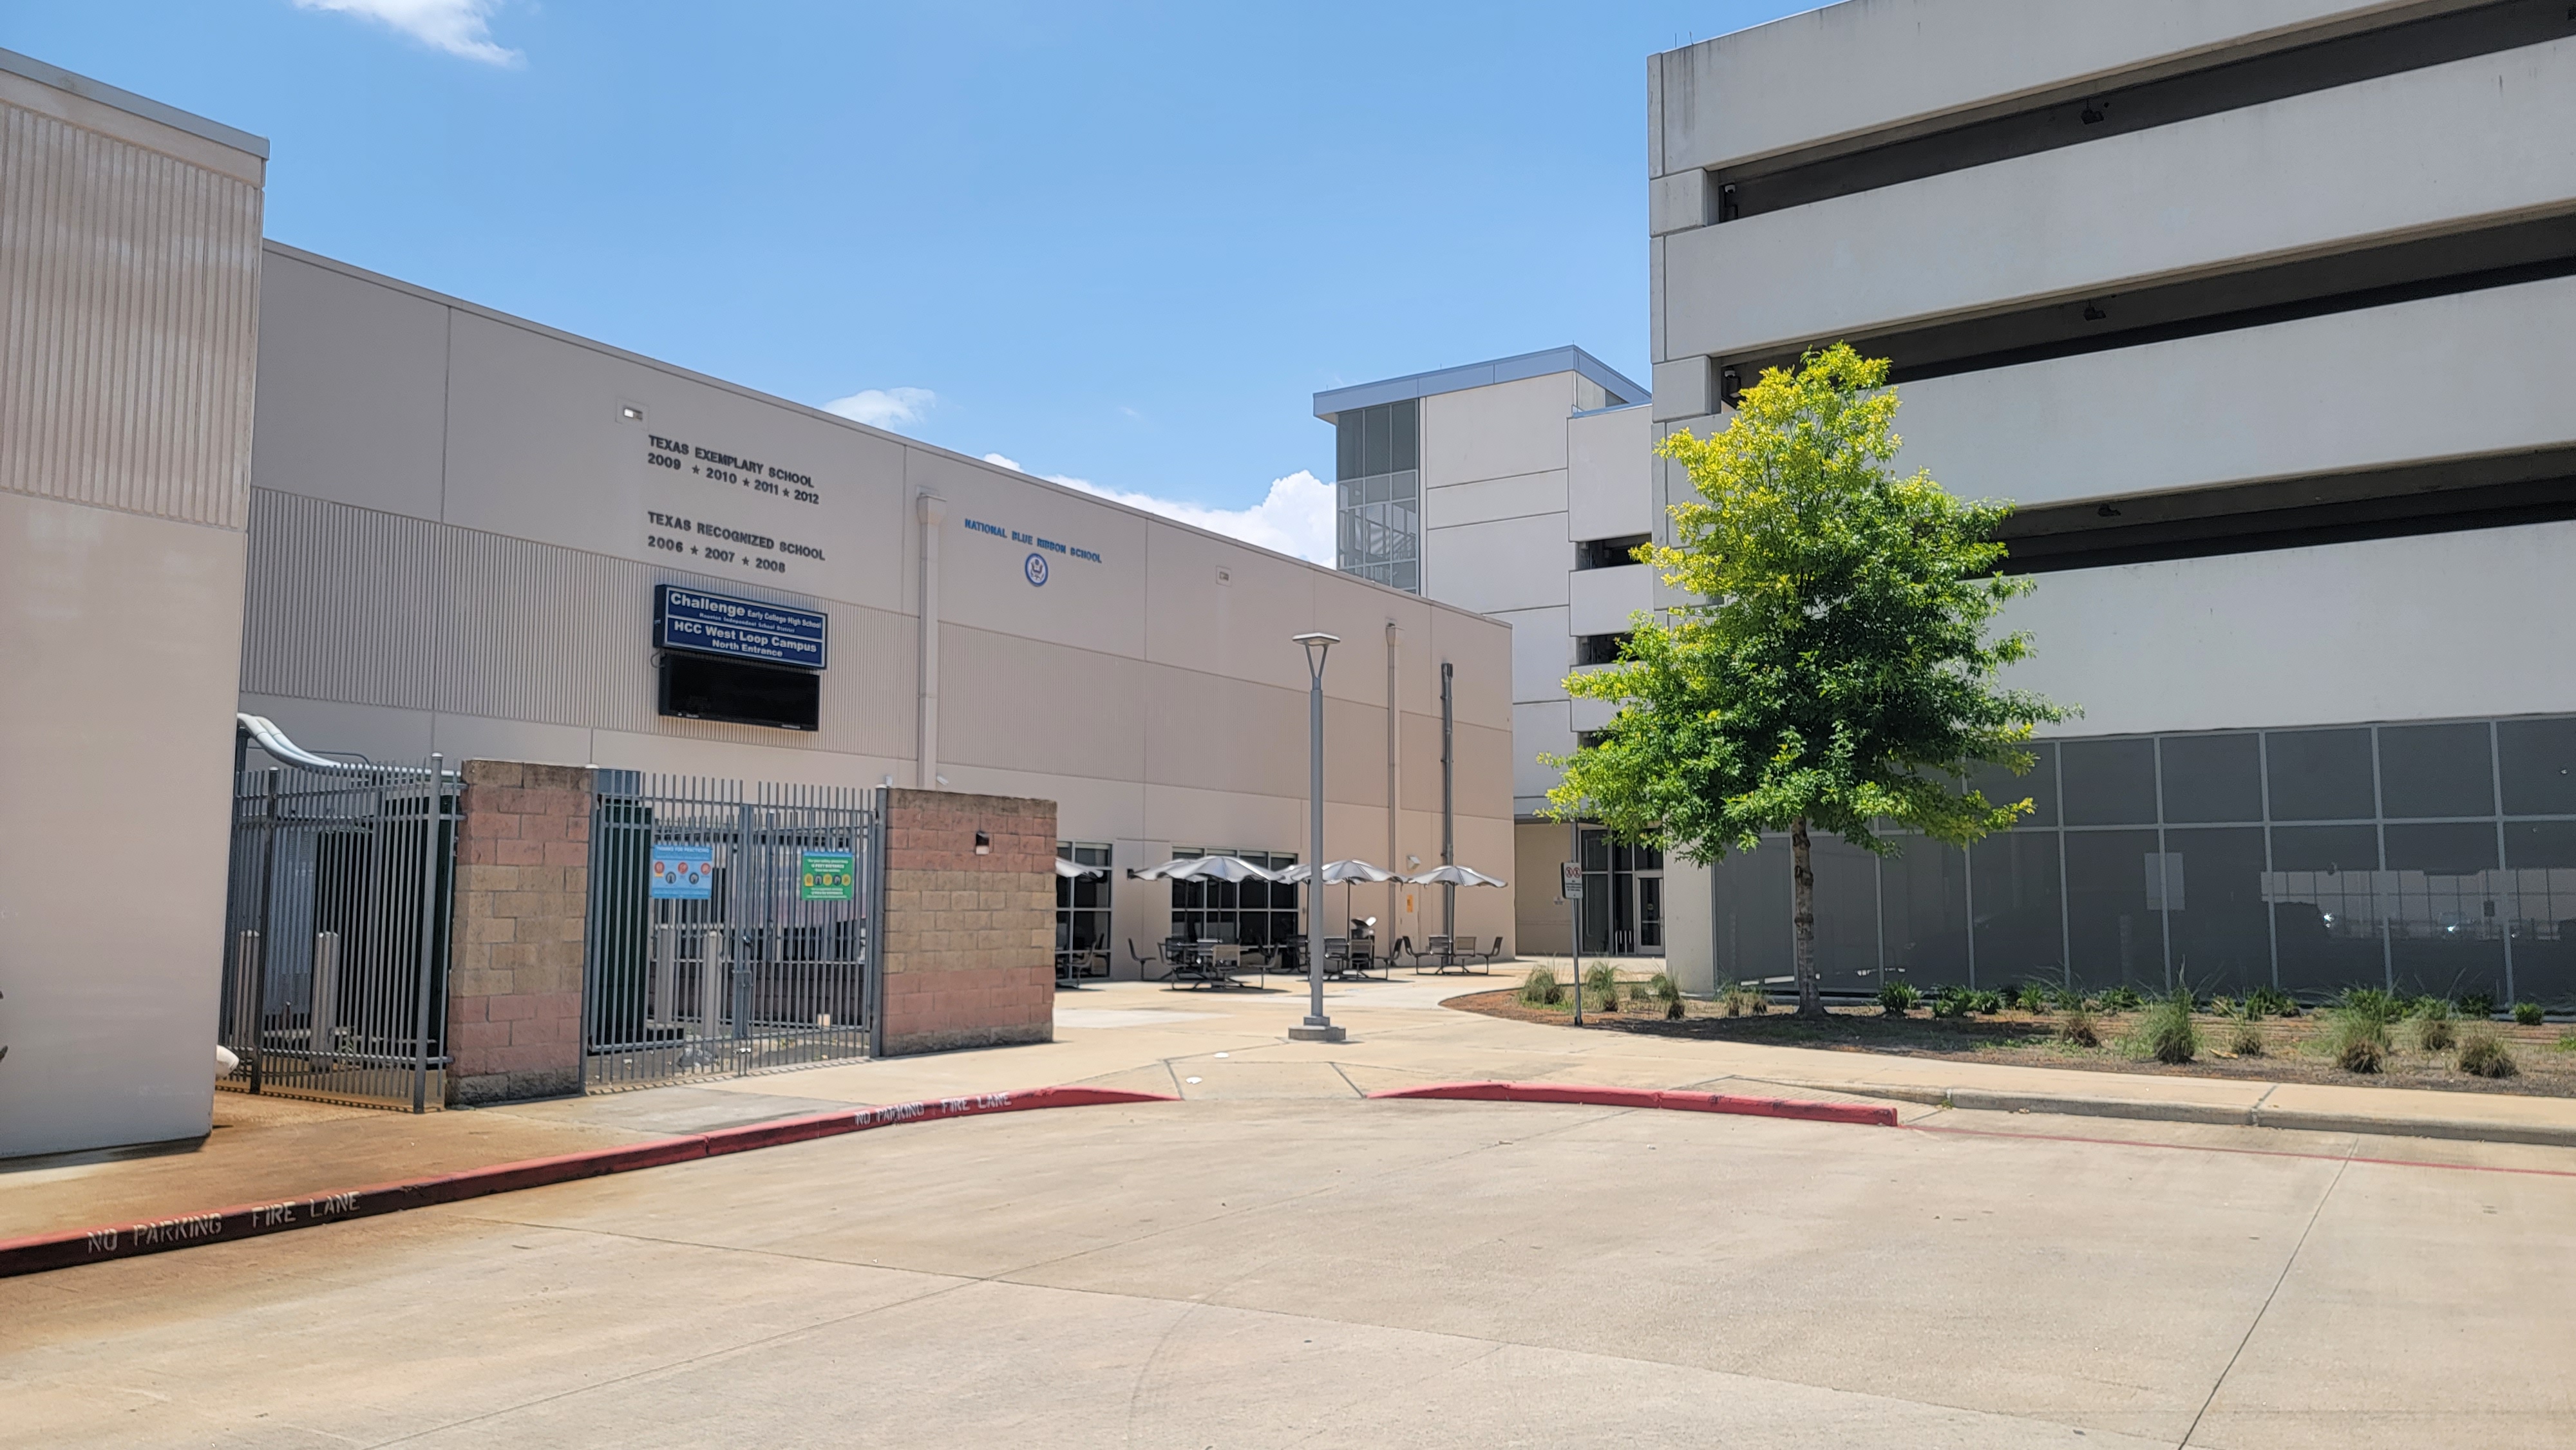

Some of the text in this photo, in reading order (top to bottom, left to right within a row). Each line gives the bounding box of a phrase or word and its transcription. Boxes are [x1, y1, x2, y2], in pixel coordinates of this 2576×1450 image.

[648, 434, 815, 488] TEXAS EXEMPLARY SCHOOL
[648, 453, 819, 505] 2009 2010 2011 2012
[648, 511, 826, 561] TEXAS RECOGNIZED SCHOOL
[648, 536, 786, 573] 2006 2007 2008
[965, 518, 1102, 563] NATIONAL BLUE RIBBON SCHOOL
[670, 593, 821, 629] Challenge Early College High School
[674, 620, 817, 653] HCC West Loop Campus
[712, 639, 783, 657] North Entrance
[855, 1091, 1012, 1126] NO PARKING FIRE LANE
[87, 1191, 361, 1254] NO PARKING FIRE LANE
